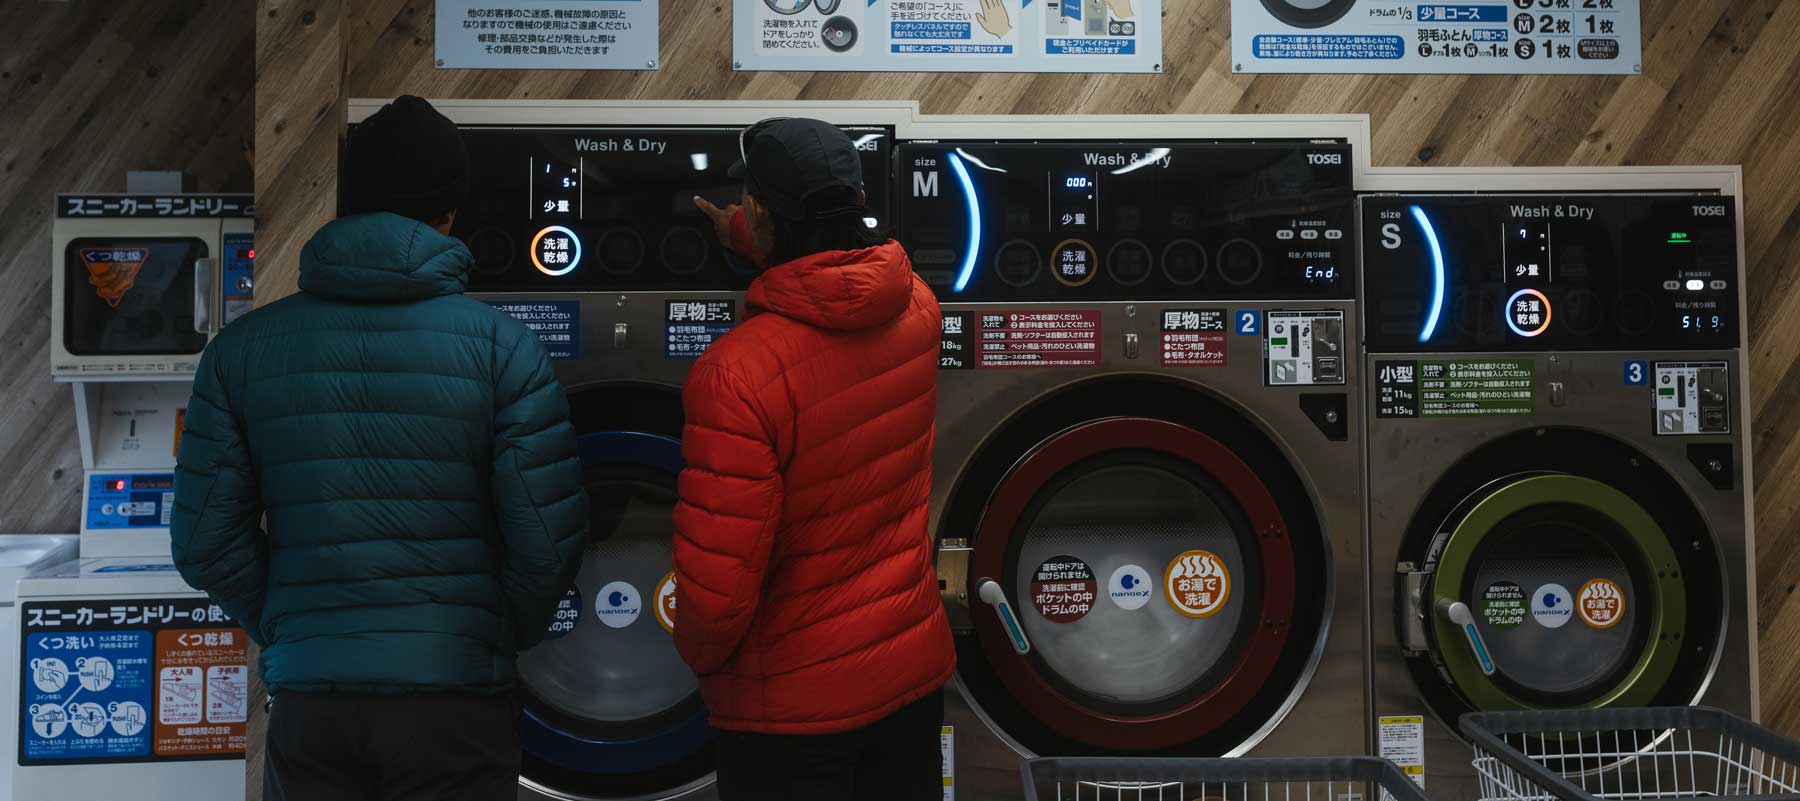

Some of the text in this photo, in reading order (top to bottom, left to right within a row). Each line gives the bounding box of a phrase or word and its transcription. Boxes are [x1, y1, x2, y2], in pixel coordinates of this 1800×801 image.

[890, 12, 971, 20] 手を近づけてください
[1420, 8, 1480, 19] 少量コース
[464, 20, 631, 30] なりますので機械の使用はご遠慮ください
[763, 20, 819, 28] 洗濯物を入れて
[1518, 20, 1531, 31] M
[763, 30, 814, 38] ドアをしっかり
[1418, 30, 1471, 42] 羽毛ふとん
[485, 45, 608, 55] その費用をご負担いただきます
[1519, 45, 1529, 57] S
[575, 139, 667, 155] Wash & Dry
[914, 157, 937, 167] size
[1083, 153, 1126, 165] Wash
[1306, 154, 1341, 165] TOSEI
[912, 171, 939, 197] M
[68, 198, 239, 215] スニーカーランドリー
[544, 200, 570, 213] 少量
[1691, 205, 1726, 216] TOSEI
[1380, 209, 1401, 219] size
[1509, 205, 1594, 220] Wash & Dry
[1061, 213, 1087, 225] 少量
[1380, 223, 1402, 249] S
[543, 238, 570, 251] 洗濯
[85, 250, 141, 262] くつ乾燥
[543, 251, 570, 264] 乾燥
[1061, 250, 1087, 262] 洗濯
[1061, 263, 1087, 275] 乾燥
[1305, 266, 1334, 279] End
[1515, 264, 1540, 276] 少量
[491, 304, 557, 312] ースをお選びください
[669, 302, 706, 321] 厚物
[1516, 300, 1540, 312] 洗濯
[707, 313, 732, 321] コース
[1164, 311, 1200, 330] 厚物
[1516, 313, 1540, 326] 乾燥
[526, 322, 571, 330] 動投入されます
[941, 316, 963, 334] 型
[983, 321, 1001, 329] 入れて
[1200, 321, 1223, 330] コース
[1240, 313, 1255, 333] 2
[941, 341, 962, 351] 18kg
[1170, 343, 1205, 351] こたつ布団
[1170, 351, 1224, 360] 毛布・タオルケット
[941, 356, 963, 367] 27kg
[1380, 365, 1414, 384] 小型
[1629, 362, 1642, 383] 3
[1394, 390, 1413, 400] 11kg
[1393, 405, 1413, 416] 15kg
[1042, 562, 1085, 572] 運転中ドアは
[1037, 571, 1090, 581] 開けられません
[1041, 583, 1086, 593] 洗濯前に確認
[1178, 578, 1217, 592] お湯で
[1035, 592, 1093, 604] ポケットの中
[1185, 592, 1211, 606] 洗濯
[1042, 603, 1089, 615] ドラムの中
[1586, 599, 1615, 609] お湯で
[1591, 609, 1610, 620] 洗濯
[1488, 616, 1523, 625] ドラムの中
[38, 635, 95, 650] くつ洗い
[176, 631, 235, 647] くつ乾燥
[170, 668, 193, 676] 大人用
[31, 705, 39, 715] 3
[110, 703, 118, 712] 5
